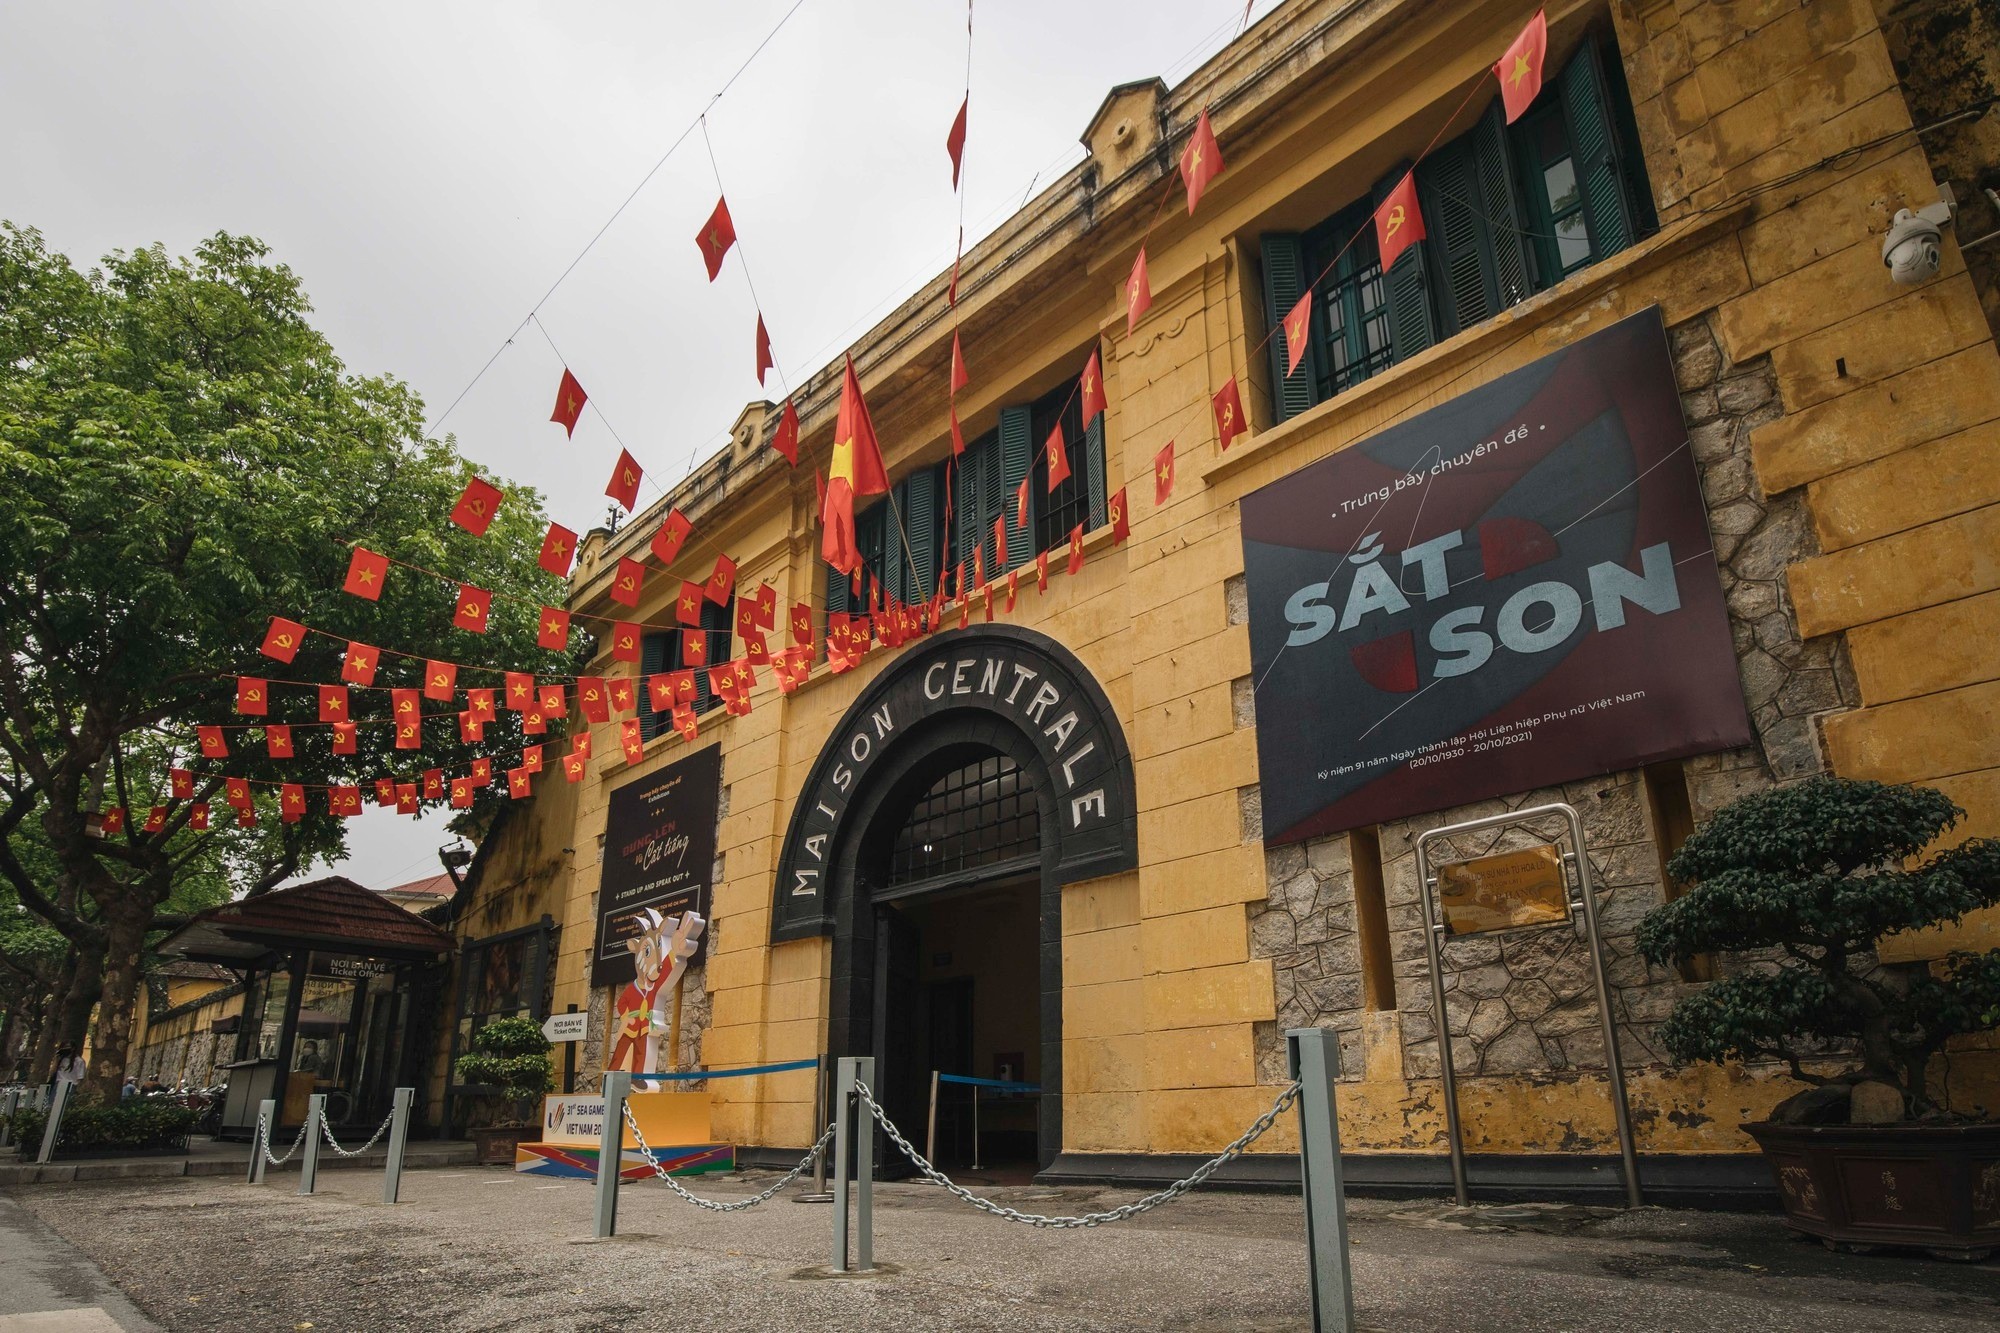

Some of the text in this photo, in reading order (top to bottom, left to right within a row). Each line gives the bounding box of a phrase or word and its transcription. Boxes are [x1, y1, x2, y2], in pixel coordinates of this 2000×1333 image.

[1340, 423, 1529, 514] Trưng bày chuyên đề
[1283, 529, 1465, 648] SẮT
[1428, 540, 1682, 679] SON
[1330, 764, 1354, 776] niệm
[1355, 761, 1365, 770] 91
[1367, 756, 1389, 767] năm
[1390, 749, 1416, 761] Ngày
[1417, 740, 1448, 754] thành
[1450, 736, 1467, 747] lập
[1469, 729, 1487, 741] Hội
[1490, 724, 1513, 736] Liên
[1515, 717, 1541, 730] hiệp
[1543, 711, 1567, 722] Phụ
[1570, 704, 1586, 716] nữ
[1588, 698, 1613, 711] Việt
[1615, 690, 1646, 704] Nam
[1409, 747, 1465, 770] (20/10/1930
[1473, 730, 1532, 753] 20/10/2021)
[791, 657, 1107, 897] MAISON CENTRALE
[621, 872, 684, 899] STAND UP AND SPEAK OUT
[331, 960, 349, 969] NƠI
[373, 963, 386, 971] VÉ
[331, 967, 385, 978] Ticket Office
[568, 1026, 582, 1034] Office
[577, 1104, 588, 1116] SEA
[588, 1104, 605, 1116] GAME
[566, 1123, 602, 1136] VIET NAM 20
